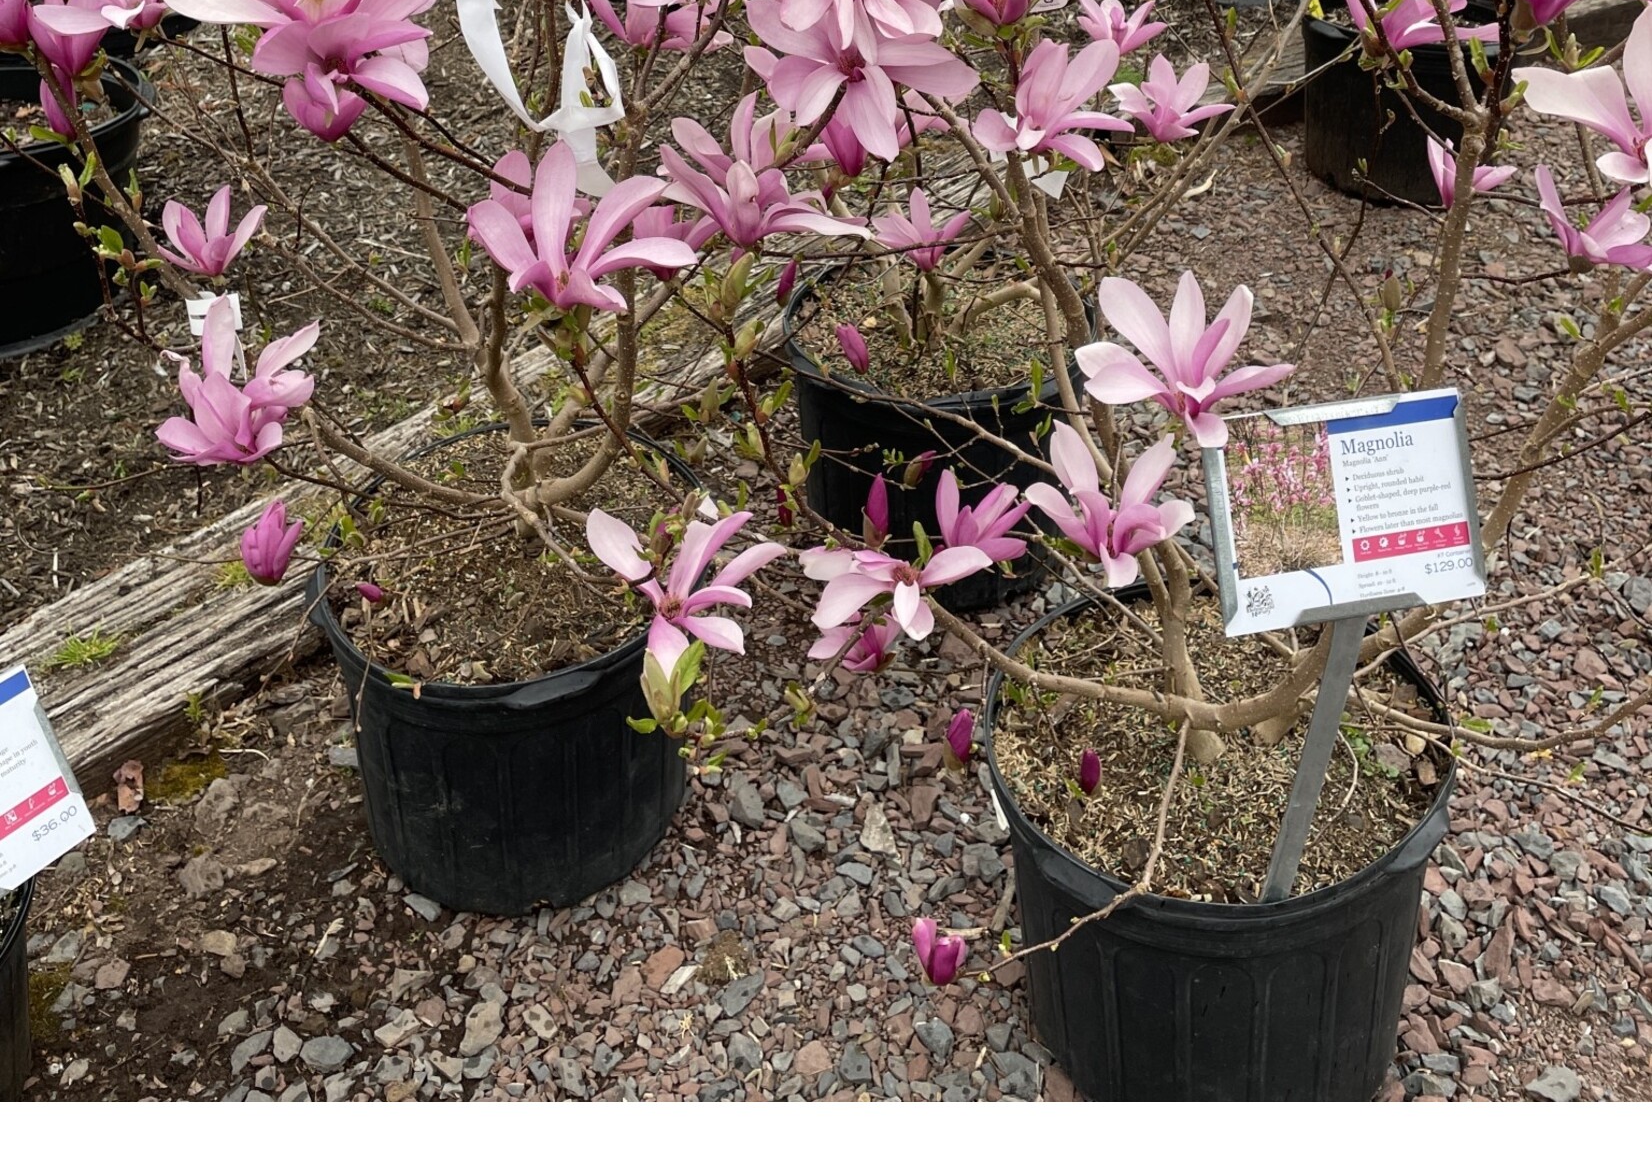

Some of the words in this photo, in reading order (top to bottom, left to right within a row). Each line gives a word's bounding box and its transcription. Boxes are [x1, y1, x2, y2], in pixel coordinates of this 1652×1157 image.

[1340, 431, 1414, 456] Magnolia
[1342, 456, 1372, 467] Magnolia
[1353, 471, 1385, 481] Deciduous
[1386, 467, 1405, 476] shrub
[1354, 482, 1380, 492] Upright,
[1381, 477, 1408, 487] rounded
[1408, 475, 1424, 484] habit
[1355, 489, 1402, 503] Goblet-shaped,
[1403, 488, 1418, 496] deep
[1419, 481, 1452, 495] purple-red
[1356, 503, 1379, 511] flowers
[1357, 514, 1379, 522] Yellow
[1387, 510, 1408, 518] bronze
[1428, 503, 1439, 511] fall
[1359, 525, 1384, 533] Flowers
[1385, 522, 1399, 530] later
[1416, 517, 1431, 525] most
[1432, 512, 1464, 522] magnolias
[1424, 557, 1473, 575] $129.00
[12, 750, 20, 758] in
[20, 738, 38, 755] youth
[1, 758, 26, 778] maturity
[32, 805, 77, 841] $36.00
